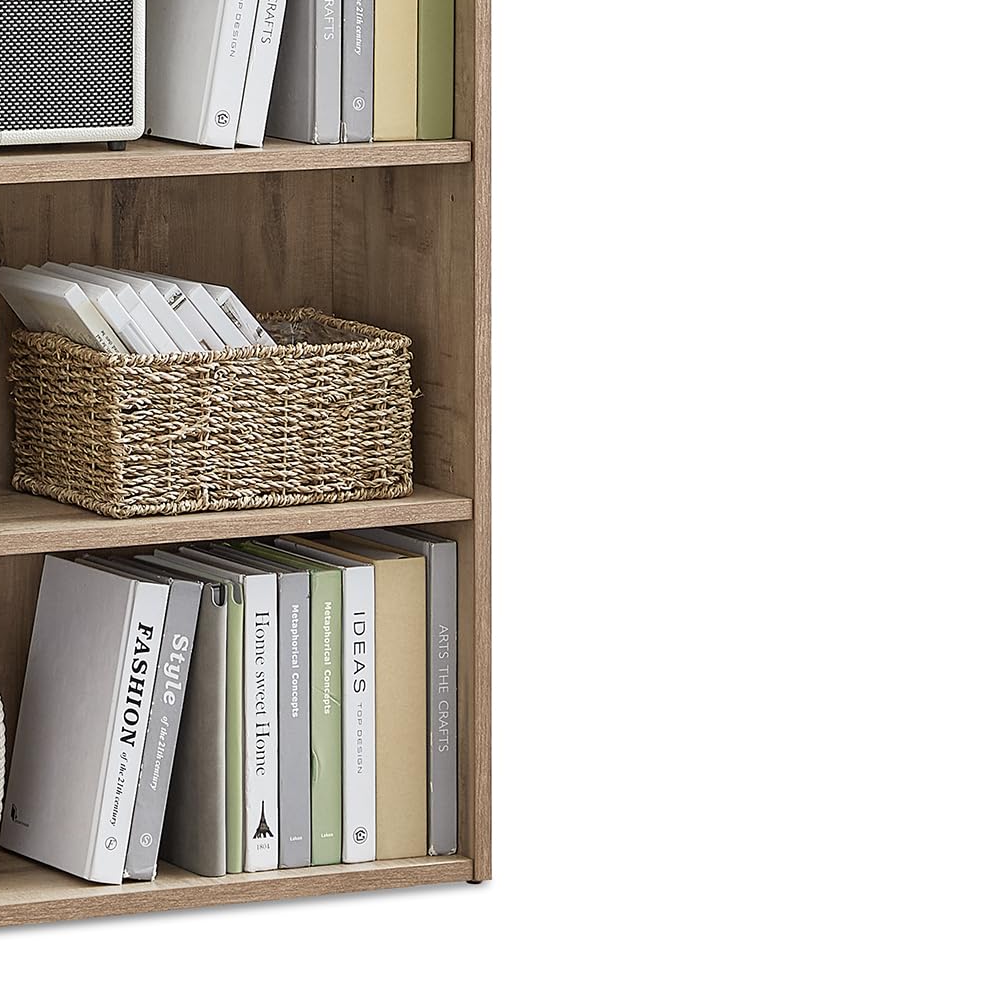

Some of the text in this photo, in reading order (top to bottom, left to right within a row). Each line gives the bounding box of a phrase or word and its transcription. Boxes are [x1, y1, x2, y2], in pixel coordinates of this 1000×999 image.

[229, 13, 242, 57] DESIGN
[354, 25, 362, 56] century
[356, 6, 364, 25] 21th
[255, 612, 270, 776] Home sweet Home
[290, 604, 300, 718] Metaphorical Concepts
[322, 601, 332, 715] Metaphorical Concepts
[353, 612, 366, 694] IDEAS
[438, 624, 449, 753] ARTS THE CRAFTS
[110, 622, 154, 826] FASHION of the 21th century
[150, 634, 189, 791] Style of the 21th century
